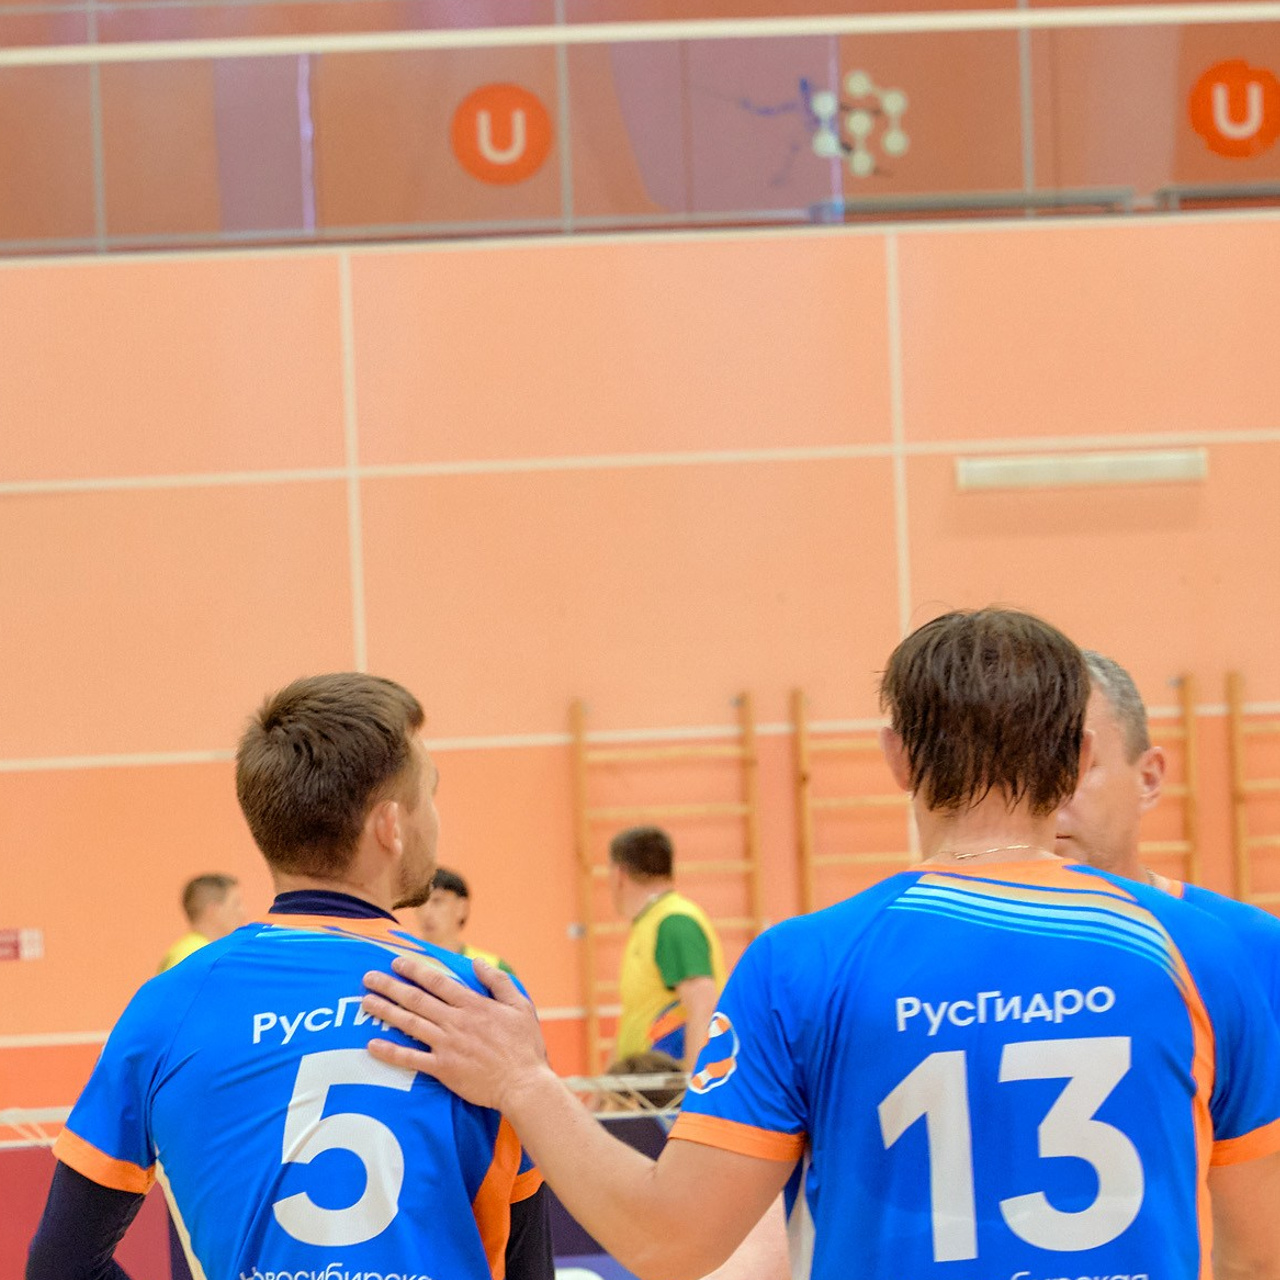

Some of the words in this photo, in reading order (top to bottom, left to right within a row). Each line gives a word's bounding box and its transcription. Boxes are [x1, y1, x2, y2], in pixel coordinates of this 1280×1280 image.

[477, 109, 526, 165] U
[1212, 82, 1263, 139] U
[895, 985, 1117, 1036] РусГидро
[271, 1047, 418, 1247] 5
[877, 1035, 1145, 1263] 13
